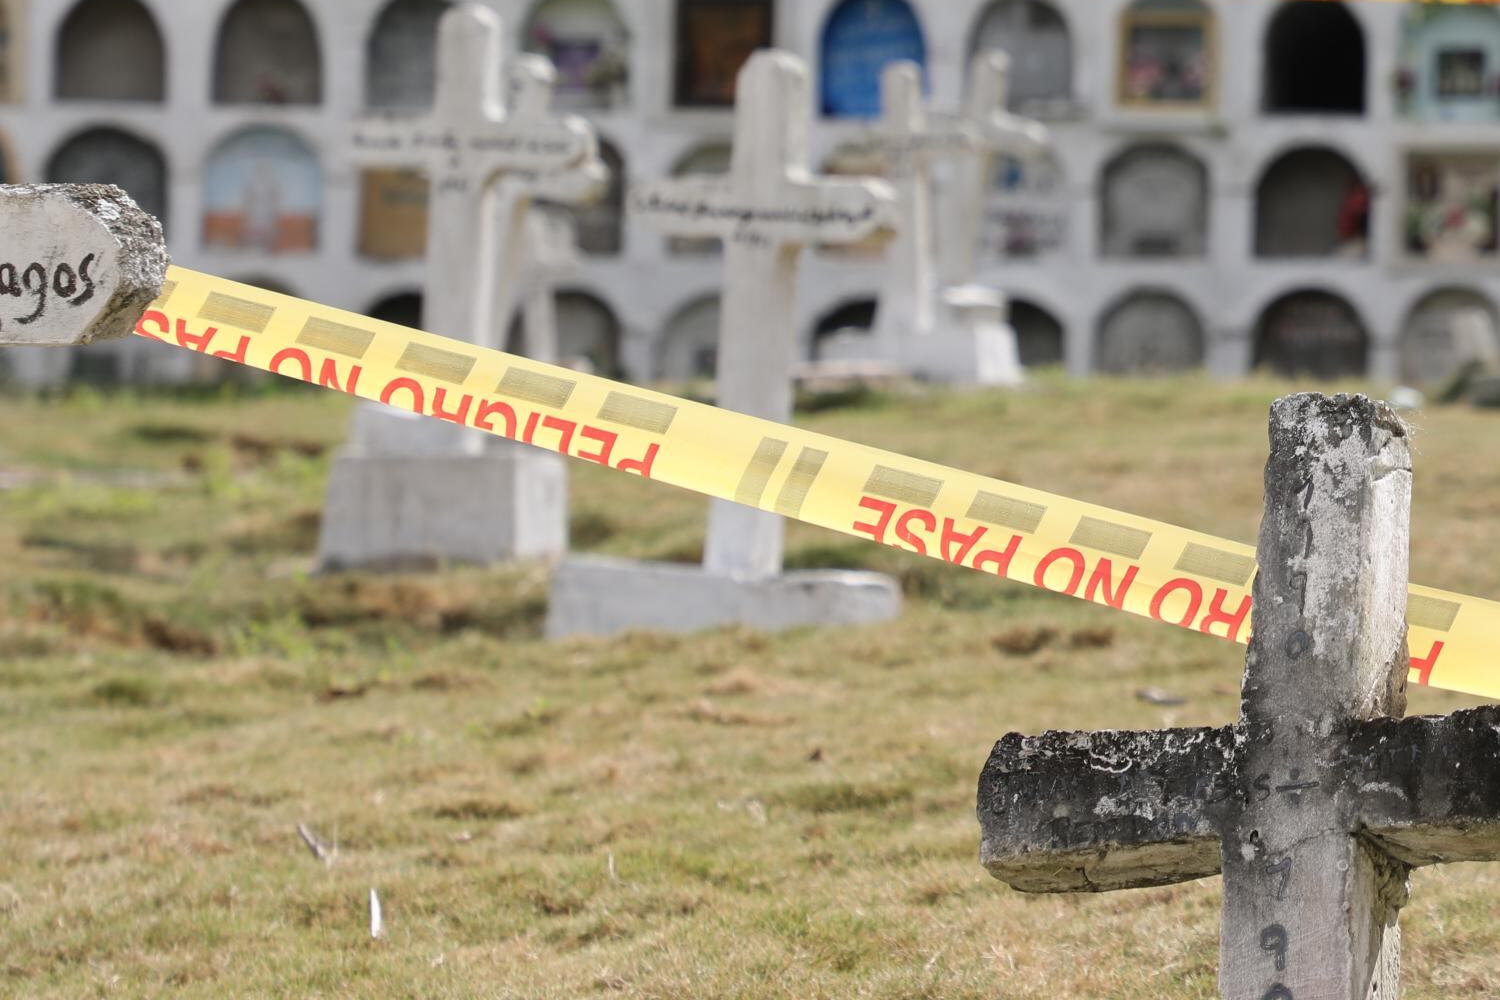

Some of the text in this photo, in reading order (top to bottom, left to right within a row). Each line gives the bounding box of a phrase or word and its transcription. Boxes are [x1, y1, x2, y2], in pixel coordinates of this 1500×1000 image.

[268, 347, 363, 396] NO
[379, 376, 661, 480] PELIGRO
[852, 495, 1023, 579] PASE
[1033, 546, 1140, 611] NO
